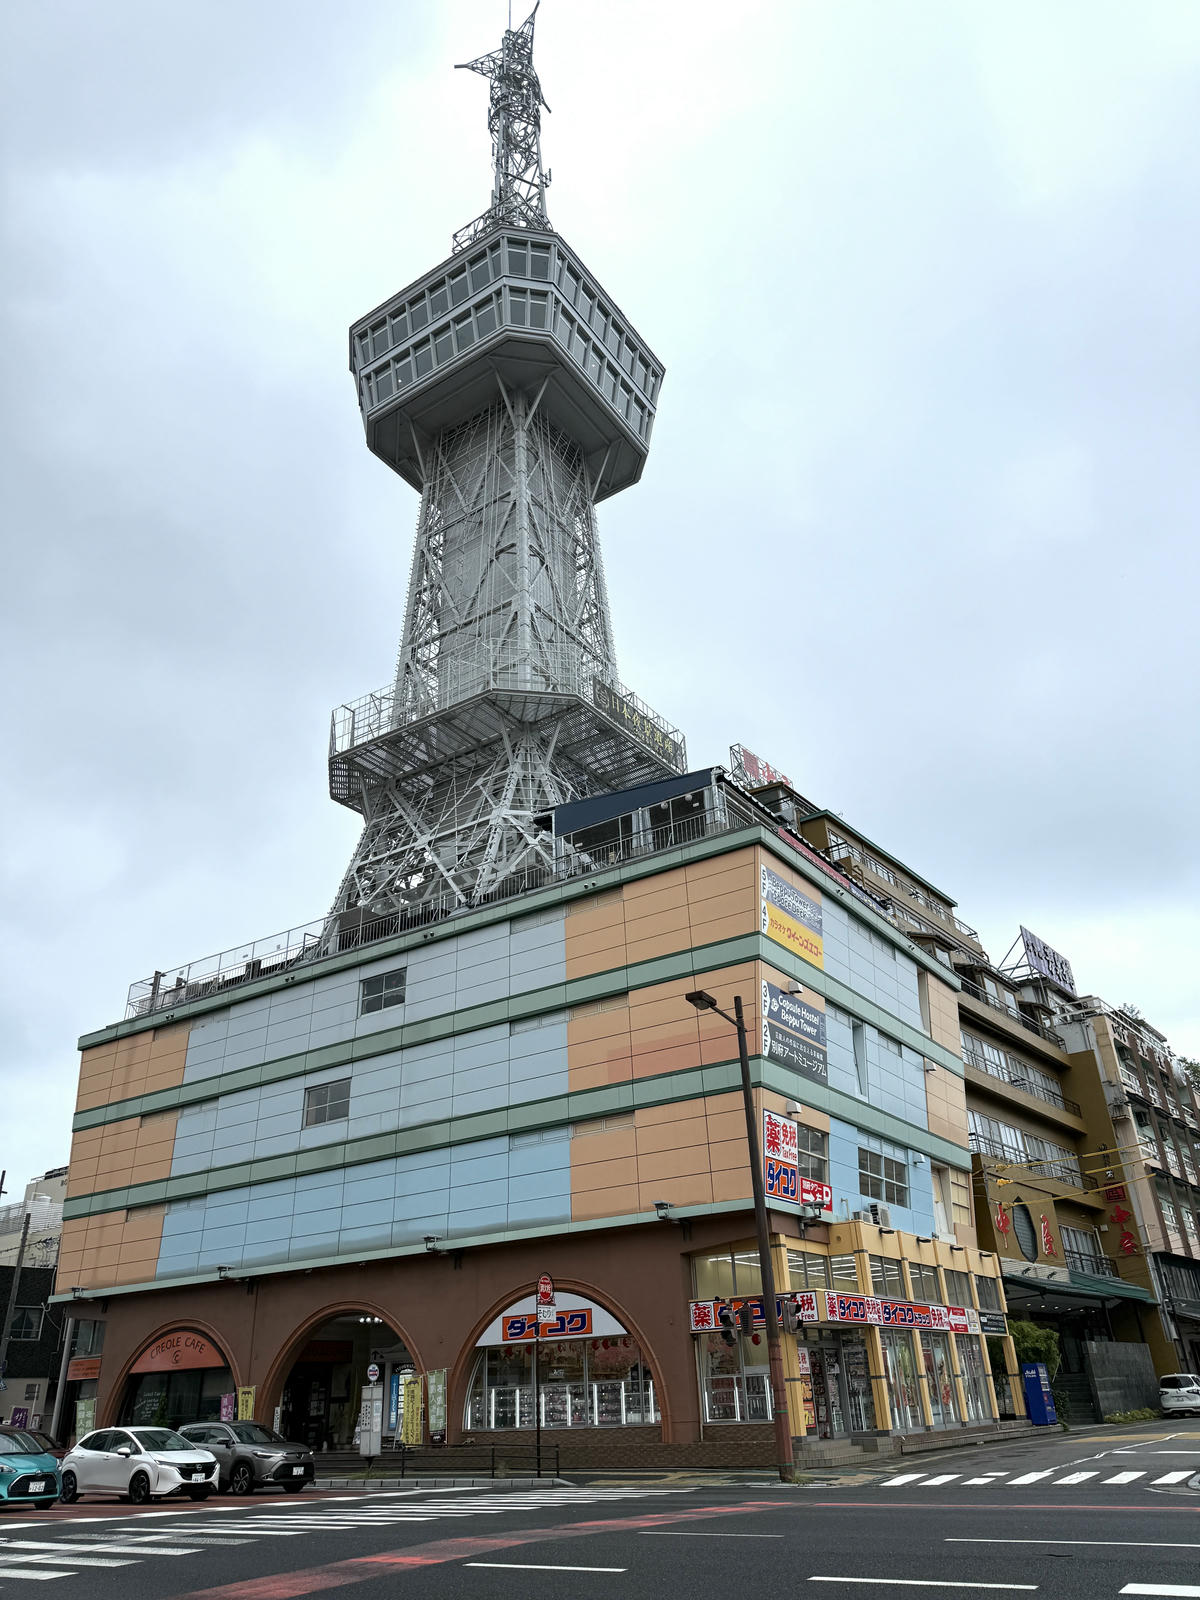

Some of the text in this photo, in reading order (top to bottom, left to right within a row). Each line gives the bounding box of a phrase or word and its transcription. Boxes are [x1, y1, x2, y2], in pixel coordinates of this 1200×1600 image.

[761, 868, 768, 896] 5F
[771, 875, 810, 911] Beppu Tower
[761, 905, 768, 931] 4F
[762, 984, 768, 1012] 3F
[778, 995, 820, 1026] Capsule Hostel
[781, 1009, 800, 1028] Beppu
[799, 1019, 818, 1036] Tower
[762, 1023, 769, 1052] 2F
[771, 1040, 827, 1077] 別府アートミュージアム
[765, 1114, 797, 1156] 薬 免税
[767, 1161, 797, 1197] ダイコク
[692, 1303, 713, 1329] 薬
[801, 1312, 815, 1321] Free
[828, 1292, 838, 1320] 薬
[839, 1299, 866, 1319] ダイコク
[883, 1304, 914, 1324] ダイコク
[507, 1311, 587, 1339] ダイコク
[150, 1336, 206, 1359] CREOLE CAFE
